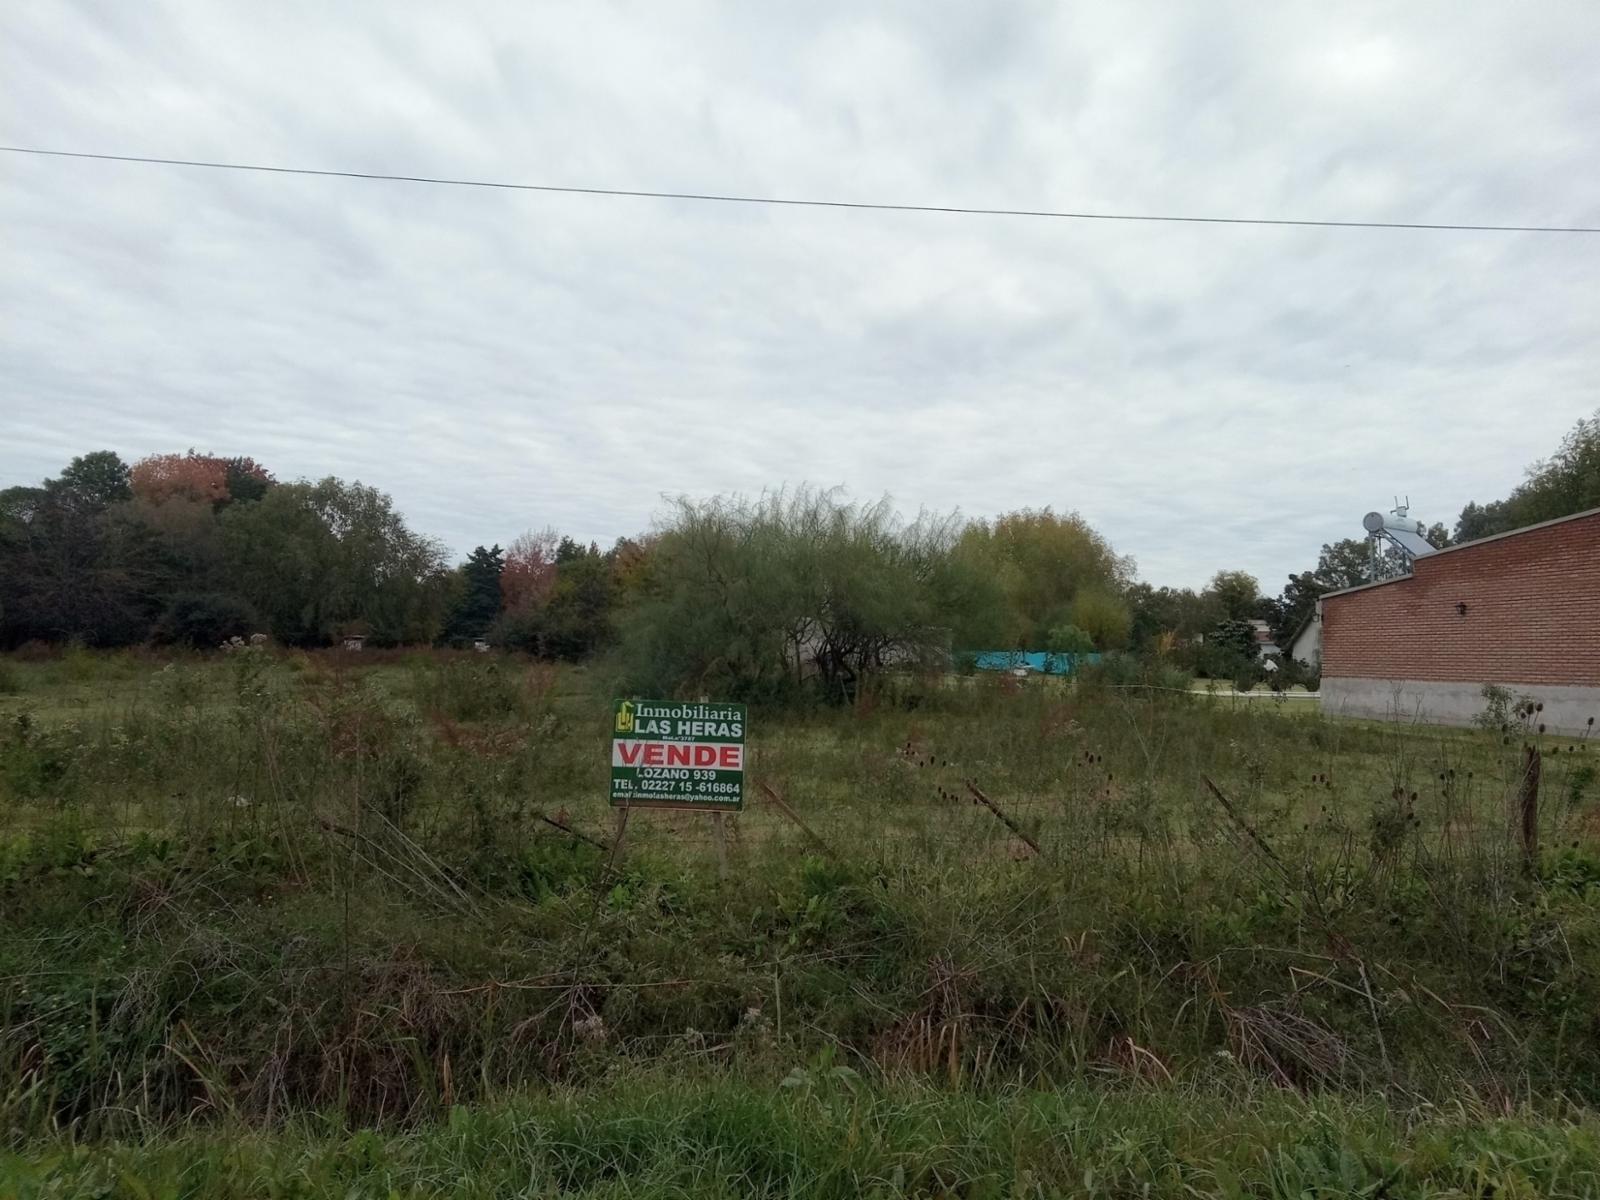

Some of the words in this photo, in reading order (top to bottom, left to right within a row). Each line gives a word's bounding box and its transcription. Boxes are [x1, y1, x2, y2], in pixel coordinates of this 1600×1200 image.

[635, 703, 742, 720] Inmobiliaria
[634, 719, 671, 734] LAS
[677, 721, 743, 737] HERAS
[617, 742, 740, 767] VENDE
[636, 768, 690, 779] LOZANO
[693, 770, 717, 780] 939
[641, 779, 675, 792] 02227
[679, 781, 693, 793] 15
